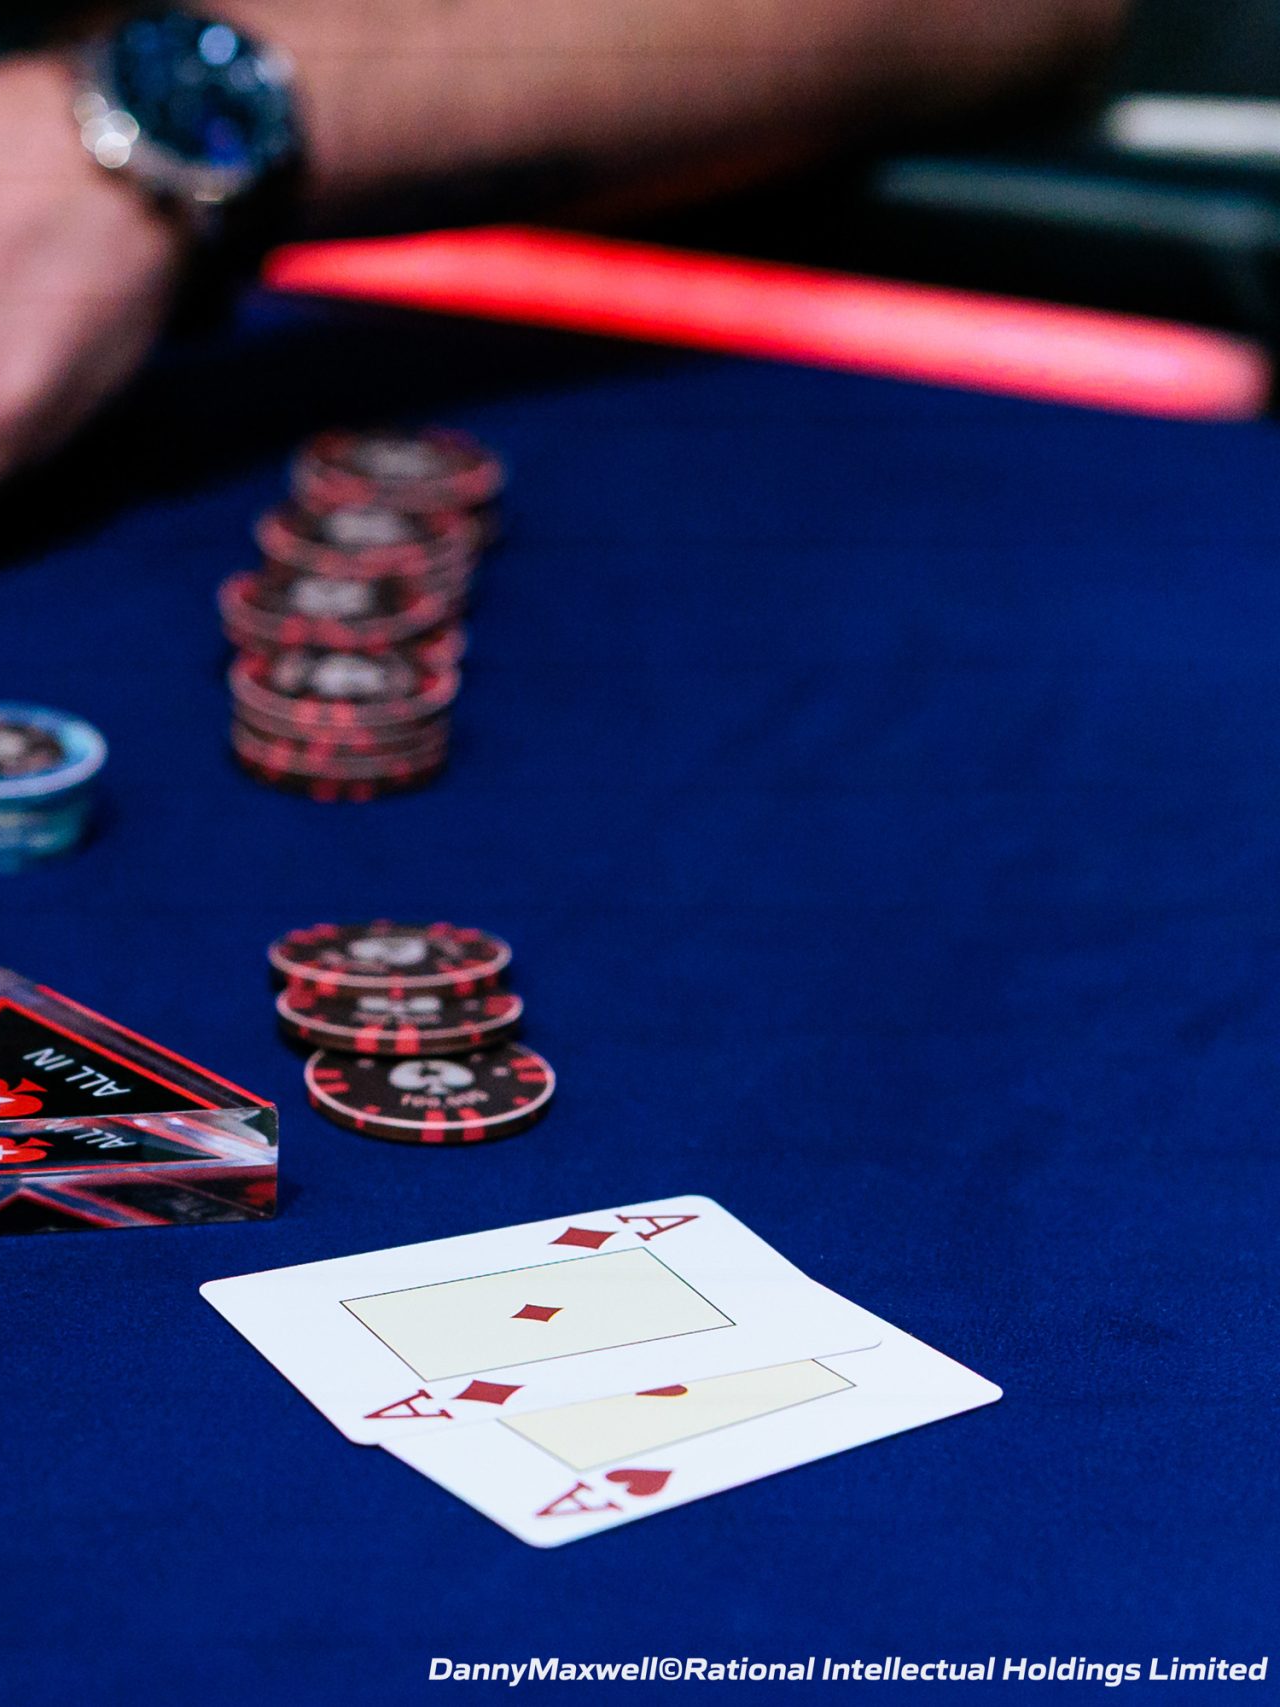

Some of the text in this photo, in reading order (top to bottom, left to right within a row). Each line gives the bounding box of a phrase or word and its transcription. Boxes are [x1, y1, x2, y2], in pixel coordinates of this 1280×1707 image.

[22, 1047, 131, 1098] ALL IN
[616, 1213, 700, 1242] A
[363, 1389, 454, 1422] A
[534, 1480, 624, 1520] A
